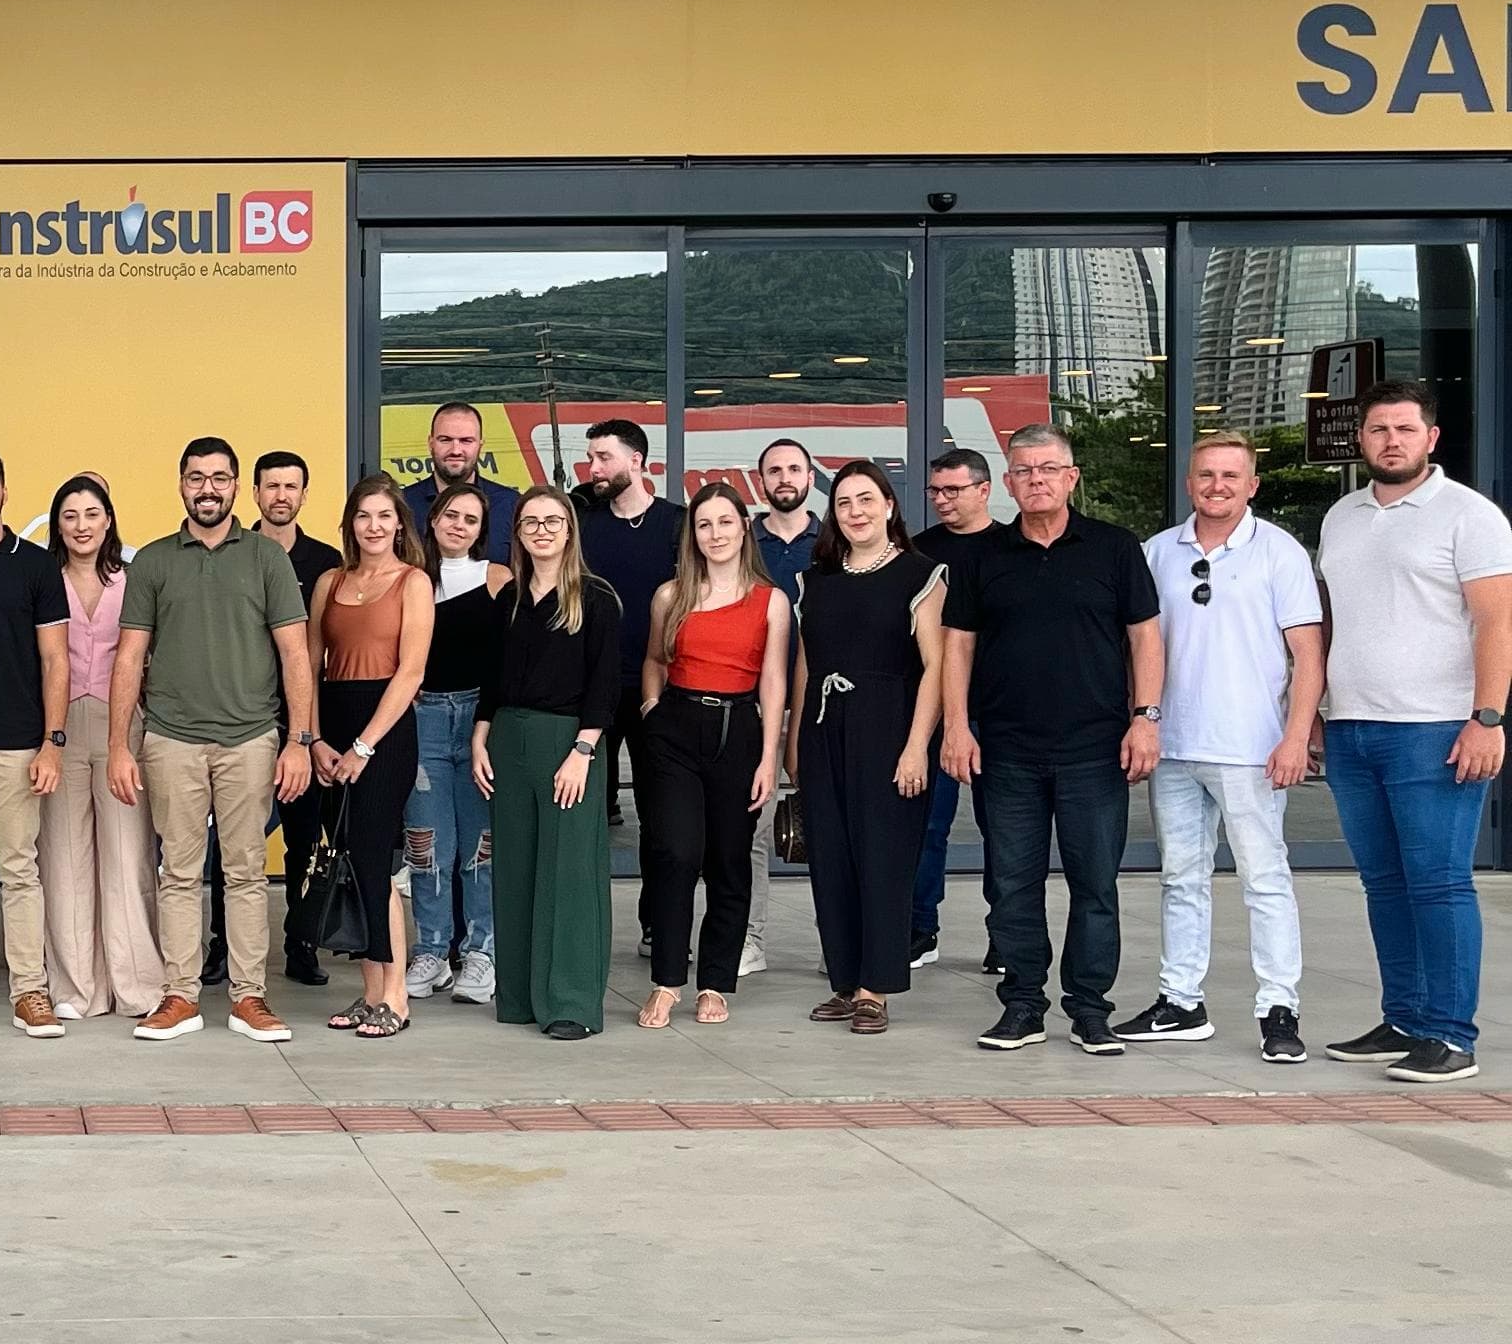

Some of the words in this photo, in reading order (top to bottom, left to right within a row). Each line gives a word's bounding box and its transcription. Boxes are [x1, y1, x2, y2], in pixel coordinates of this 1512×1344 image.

[244, 199, 310, 246] BC
[14, 262, 33, 278] da
[37, 261, 94, 278] Indústria
[97, 261, 115, 278] da
[118, 261, 196, 281] Construção
[199, 264, 209, 277] e
[212, 260, 297, 277] Acabamento
